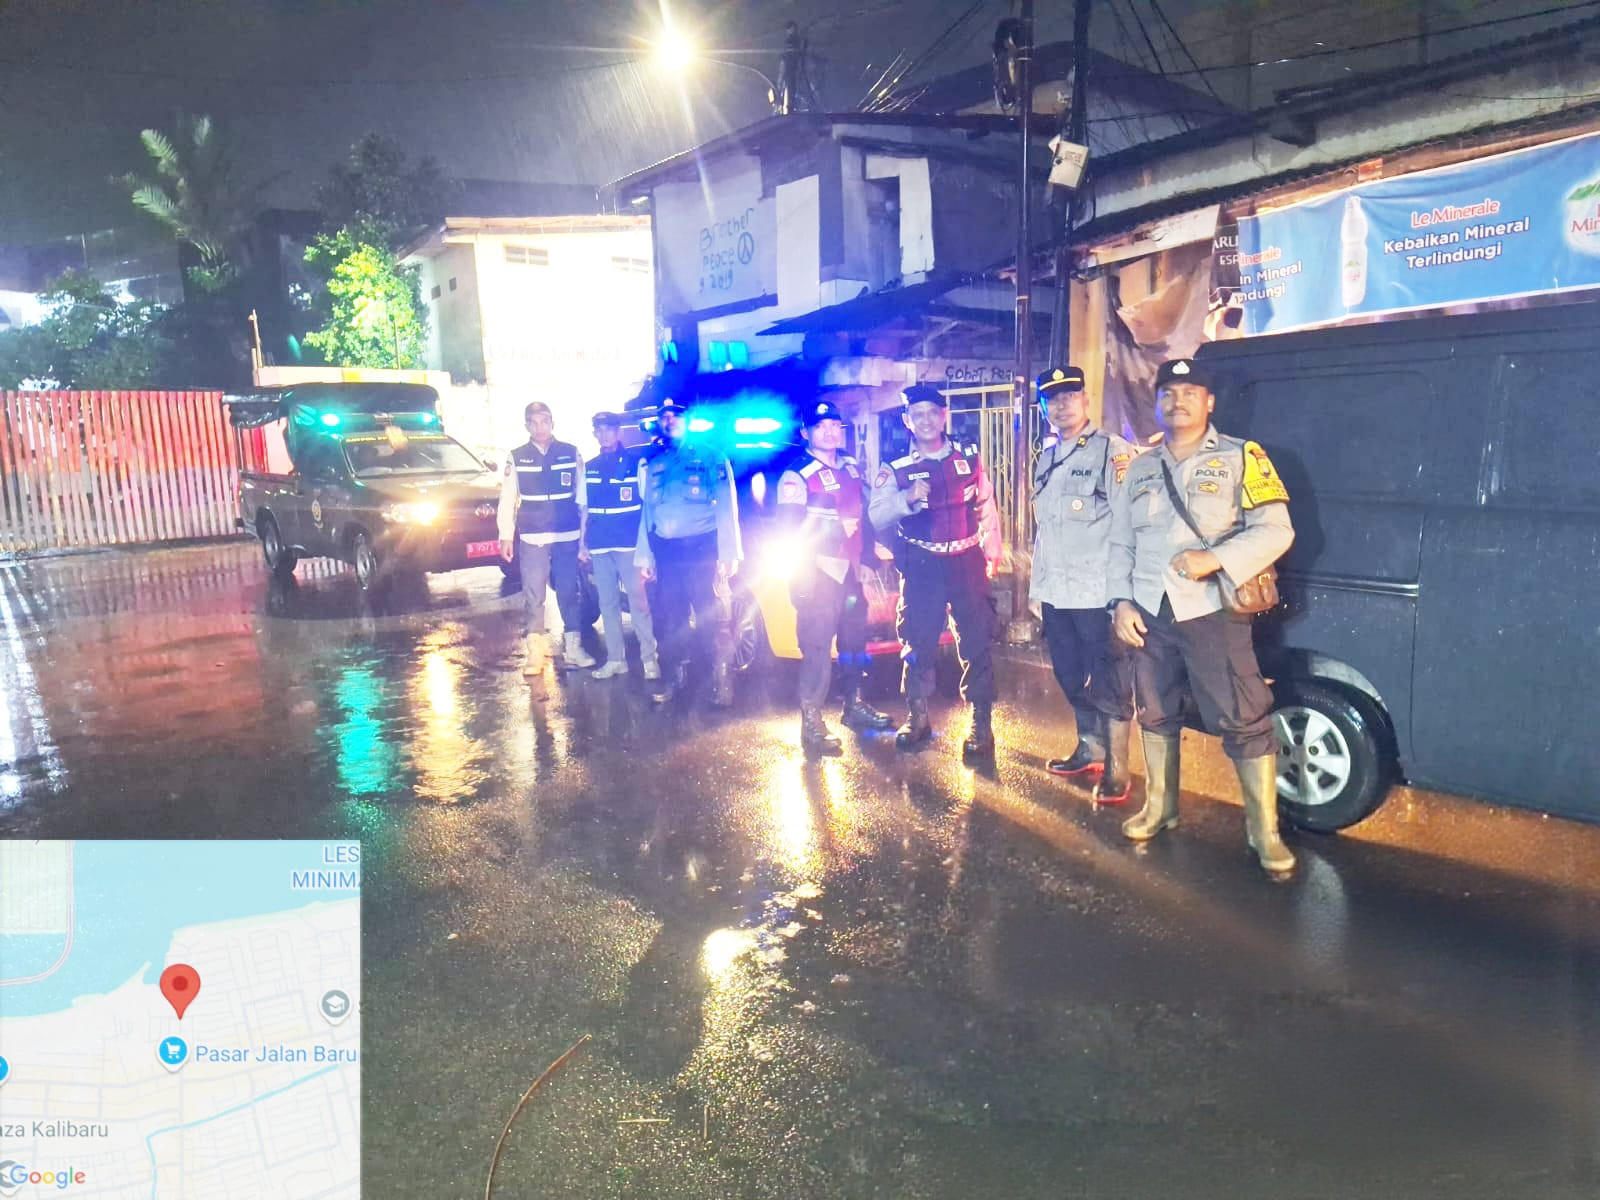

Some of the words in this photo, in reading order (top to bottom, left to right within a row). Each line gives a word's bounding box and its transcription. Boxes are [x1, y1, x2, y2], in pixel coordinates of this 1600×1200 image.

[1412, 212, 1430, 227] Le
[1433, 199, 1499, 222] Minerale
[1384, 231, 1460, 254] Kebaikan
[1465, 217, 1530, 241] Mineral
[1407, 242, 1502, 269] Terlindungi
[1257, 260, 1302, 283] Mineral
[1071, 469, 1093, 478] POLRI
[1195, 469, 1229, 479] POLRI
